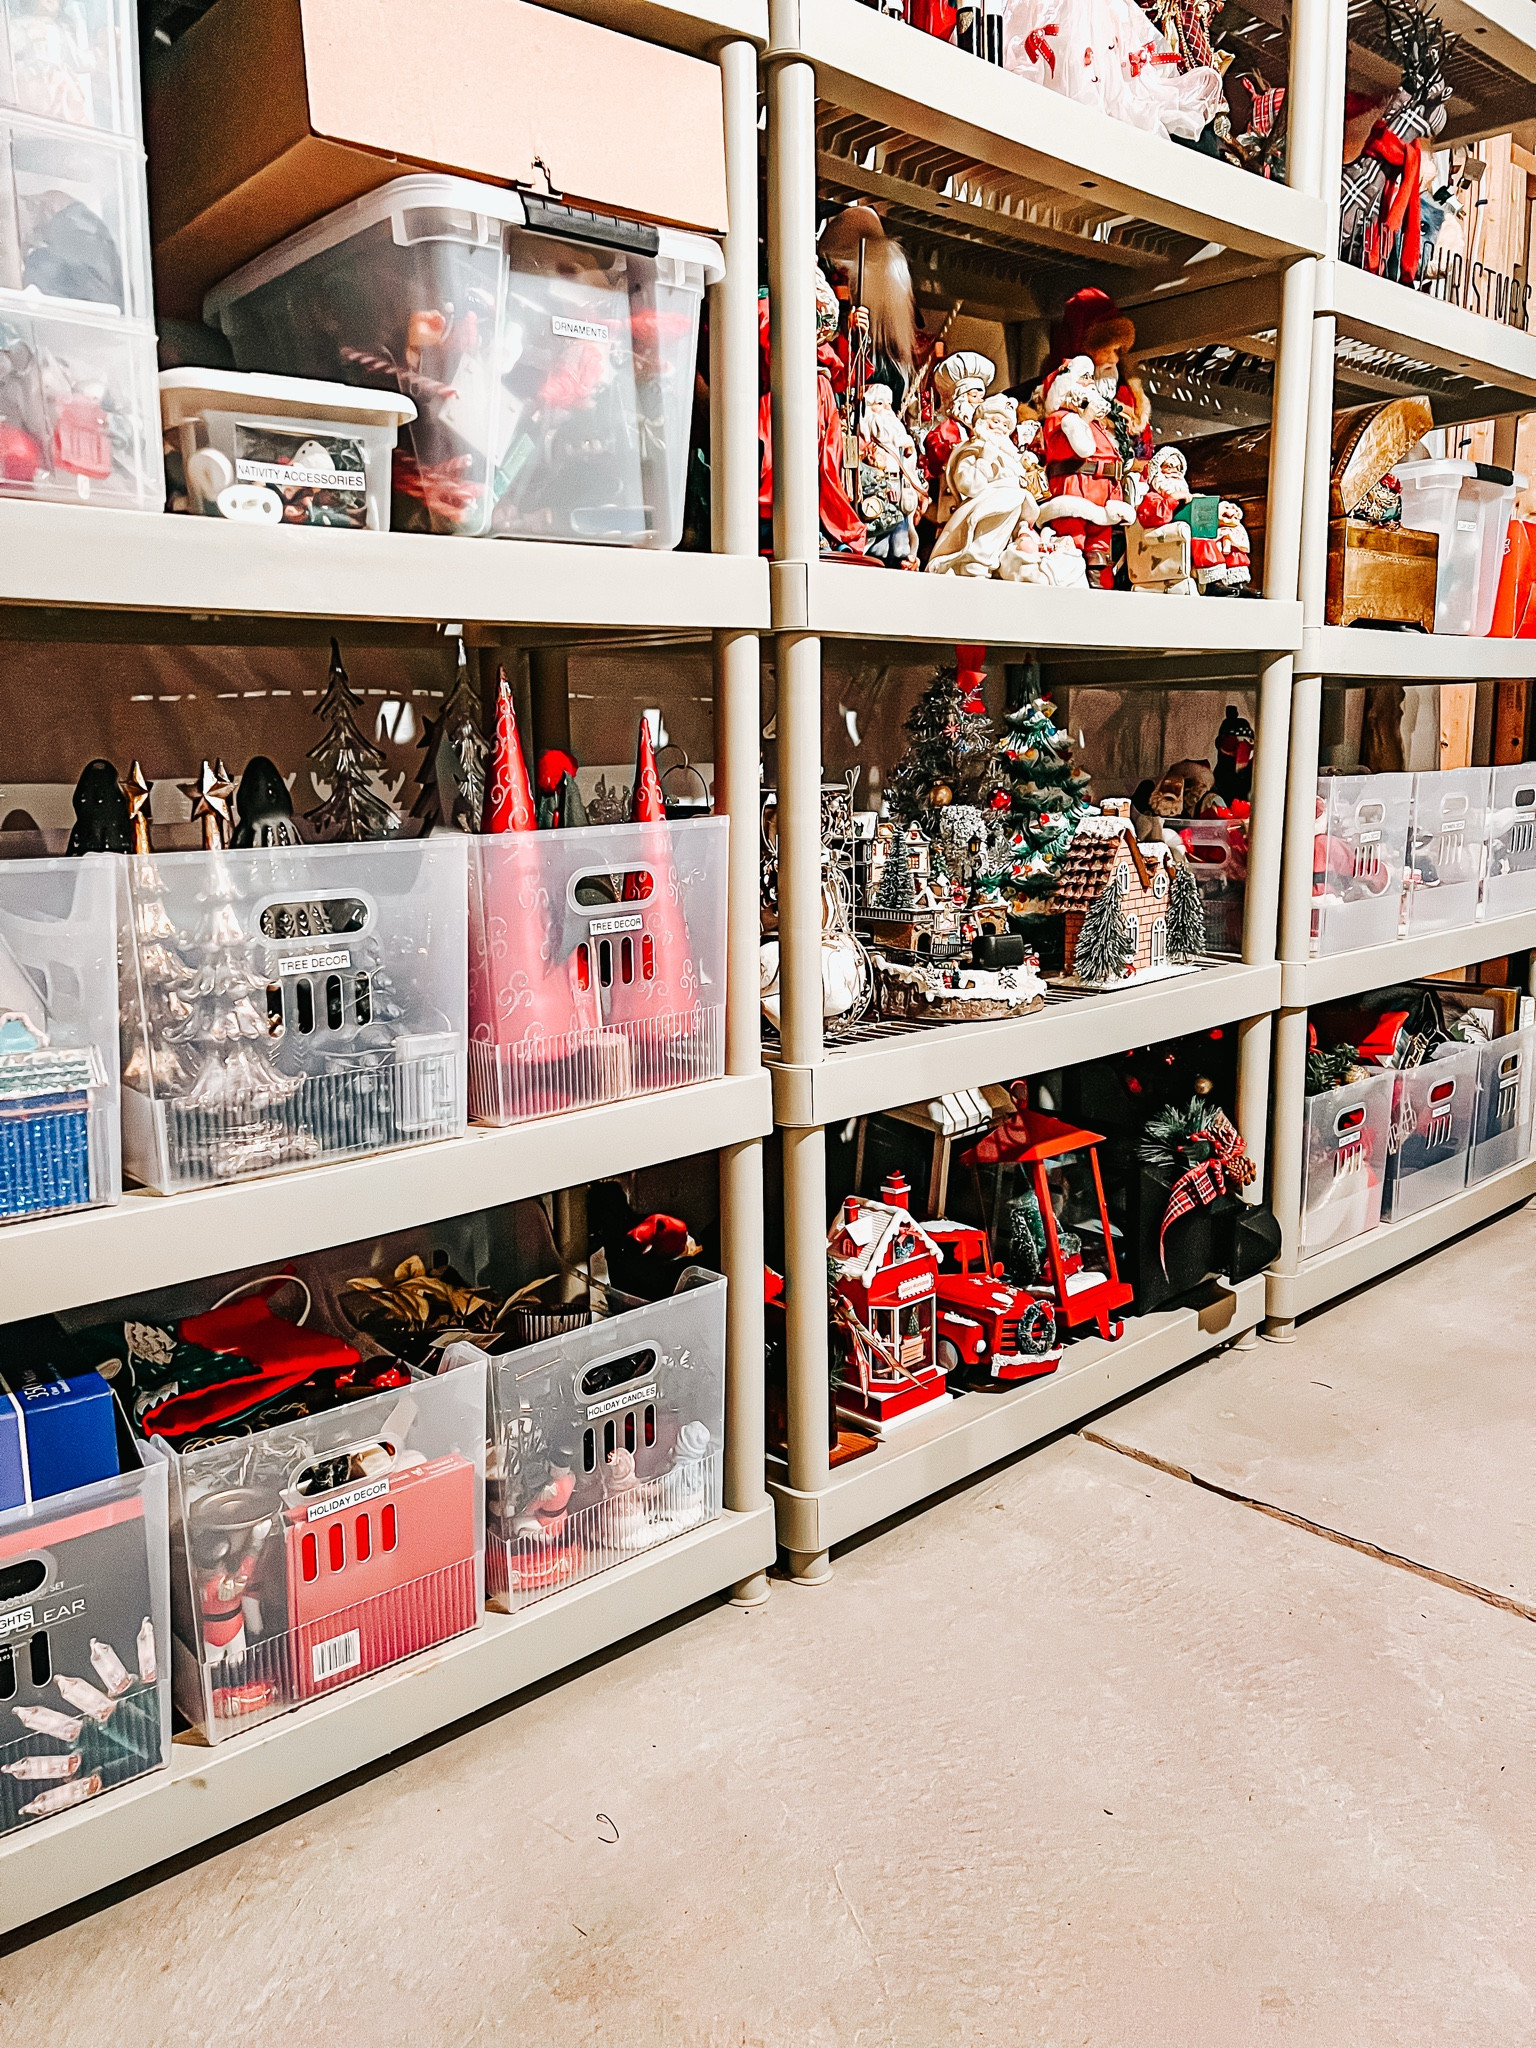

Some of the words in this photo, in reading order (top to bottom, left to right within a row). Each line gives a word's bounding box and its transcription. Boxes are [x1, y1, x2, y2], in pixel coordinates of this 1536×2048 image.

[1419, 240, 1532, 332] CHRISTMAS
[554, 320, 608, 339] ORNAMENTS
[238, 464, 280, 479] NATIVITY
[283, 470, 363, 487] ACCESSORIES
[591, 921, 612, 931] TREE
[614, 917, 641, 928] DECOR
[280, 959, 308, 971] TREE
[311, 954, 348, 967] DECOR
[588, 1400, 620, 1416] HOLIDAY
[621, 1386, 656, 1405] CANDLES
[309, 1495, 351, 1518] HOLIDAY
[353, 1482, 387, 1502] DECOR
[49, 1580, 65, 1592] SET
